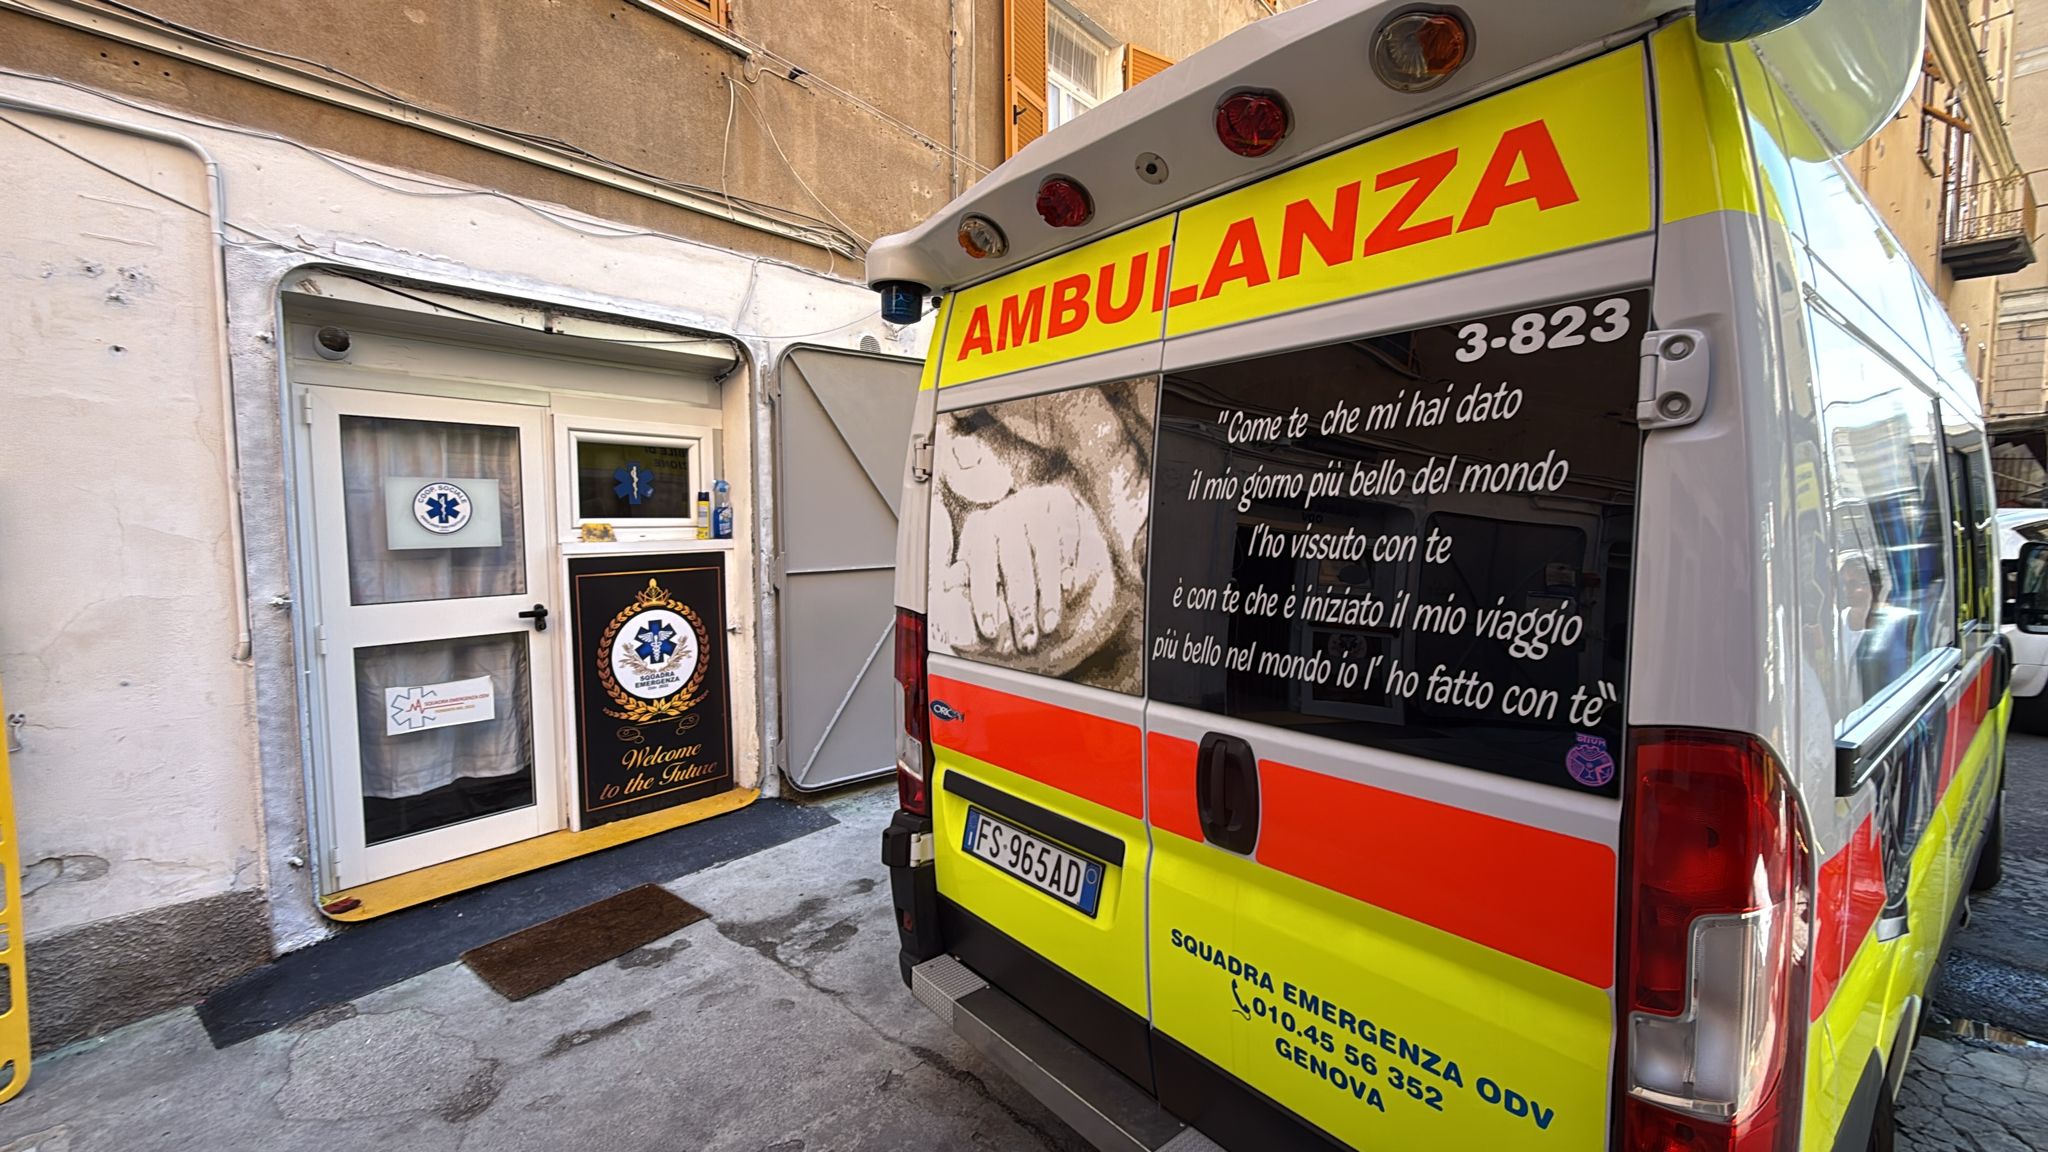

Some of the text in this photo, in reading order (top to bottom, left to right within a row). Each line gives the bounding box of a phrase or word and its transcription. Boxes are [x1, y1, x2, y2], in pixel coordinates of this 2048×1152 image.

[957, 118, 1580, 361] AMBULANZA
[1455, 298, 1630, 363] 3-823
[1287, 406, 1309, 438] te
[1320, 399, 1361, 436] che
[1365, 389, 1405, 431] mi
[1405, 383, 1454, 427] hai
[1455, 381, 1523, 423] dato
[438, 485, 467, 503] SOCIALE
[1187, 449, 1569, 513] il mio giorno più bello del mondo
[1248, 522, 1452, 564] l'ho vissuto con te
[1172, 577, 1583, 660] è con te che è iniziato il mio viaggio
[635, 676, 680, 689] EMERGENZA
[640, 671, 675, 681] SQUADRA
[1151, 628, 1179, 661] più
[1182, 632, 1221, 667] bello
[1225, 641, 1257, 671] nel
[1258, 649, 1331, 684] mondo
[1336, 650, 1358, 688] io
[1385, 659, 1419, 698] ho
[1425, 664, 1494, 710] fatto
[1502, 685, 1558, 720] con
[600, 761, 718, 801] to the Future
[621, 743, 702, 771] Welcome
[1171, 928, 1555, 1130] SQUADRA EMERGENZA ODV
[1252, 996, 1444, 1112] 010.45 56 352
[1275, 1037, 1385, 1113] GENOVA
